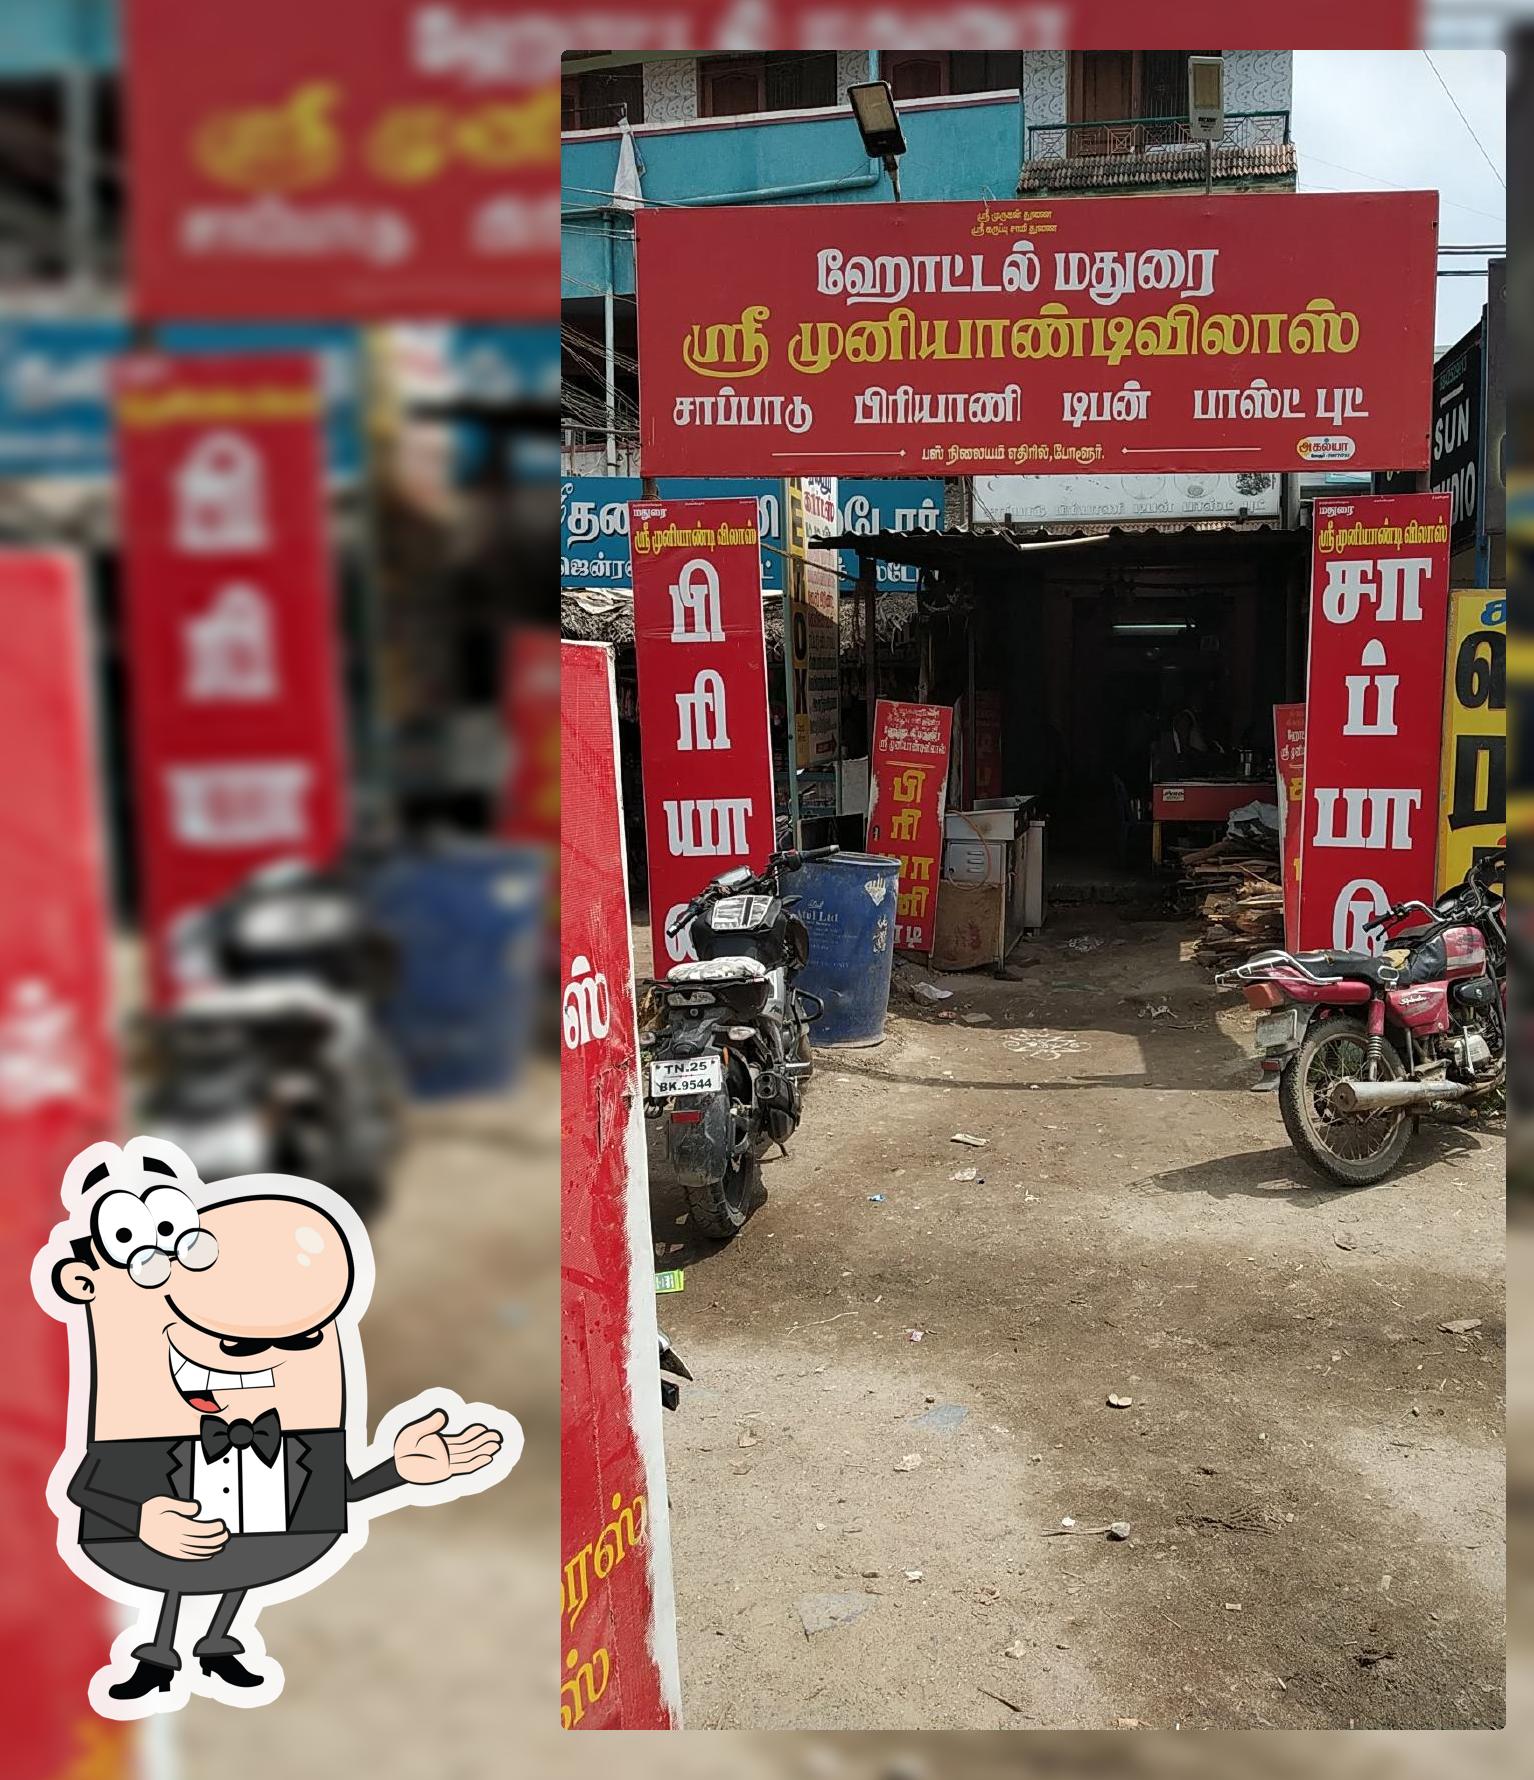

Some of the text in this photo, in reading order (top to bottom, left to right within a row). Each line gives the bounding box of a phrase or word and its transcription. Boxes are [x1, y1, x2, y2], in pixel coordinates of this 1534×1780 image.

[816, 240, 1220, 306] ஹோட்டல் மதுரை
[682, 305, 771, 378] ஸ்ரீ
[787, 298, 1360, 374] முனியாண்டிவிலாஸ்
[673, 378, 1370, 434] சாப்பாடு பிரியாணி டிபன் பாஸ்ட் புட்
[1433, 398, 1470, 461] SUN
[921, 445, 944, 461] பஸ்
[945, 444, 1005, 466] நிலையம்
[633, 508, 667, 520] மதுரை
[1319, 505, 1354, 517] மதுரை
[635, 521, 651, 554] ஸ்ரீ
[652, 520, 717, 555] முனியாண்டி
[717, 519, 757, 546] விலாஸ்
[1318, 515, 1448, 554] ஸ்ரீ முனியாண்டி விலாஸ்
[659, 1078, 712, 1092] BK.9544
[664, 1062, 707, 1075] TN.25
